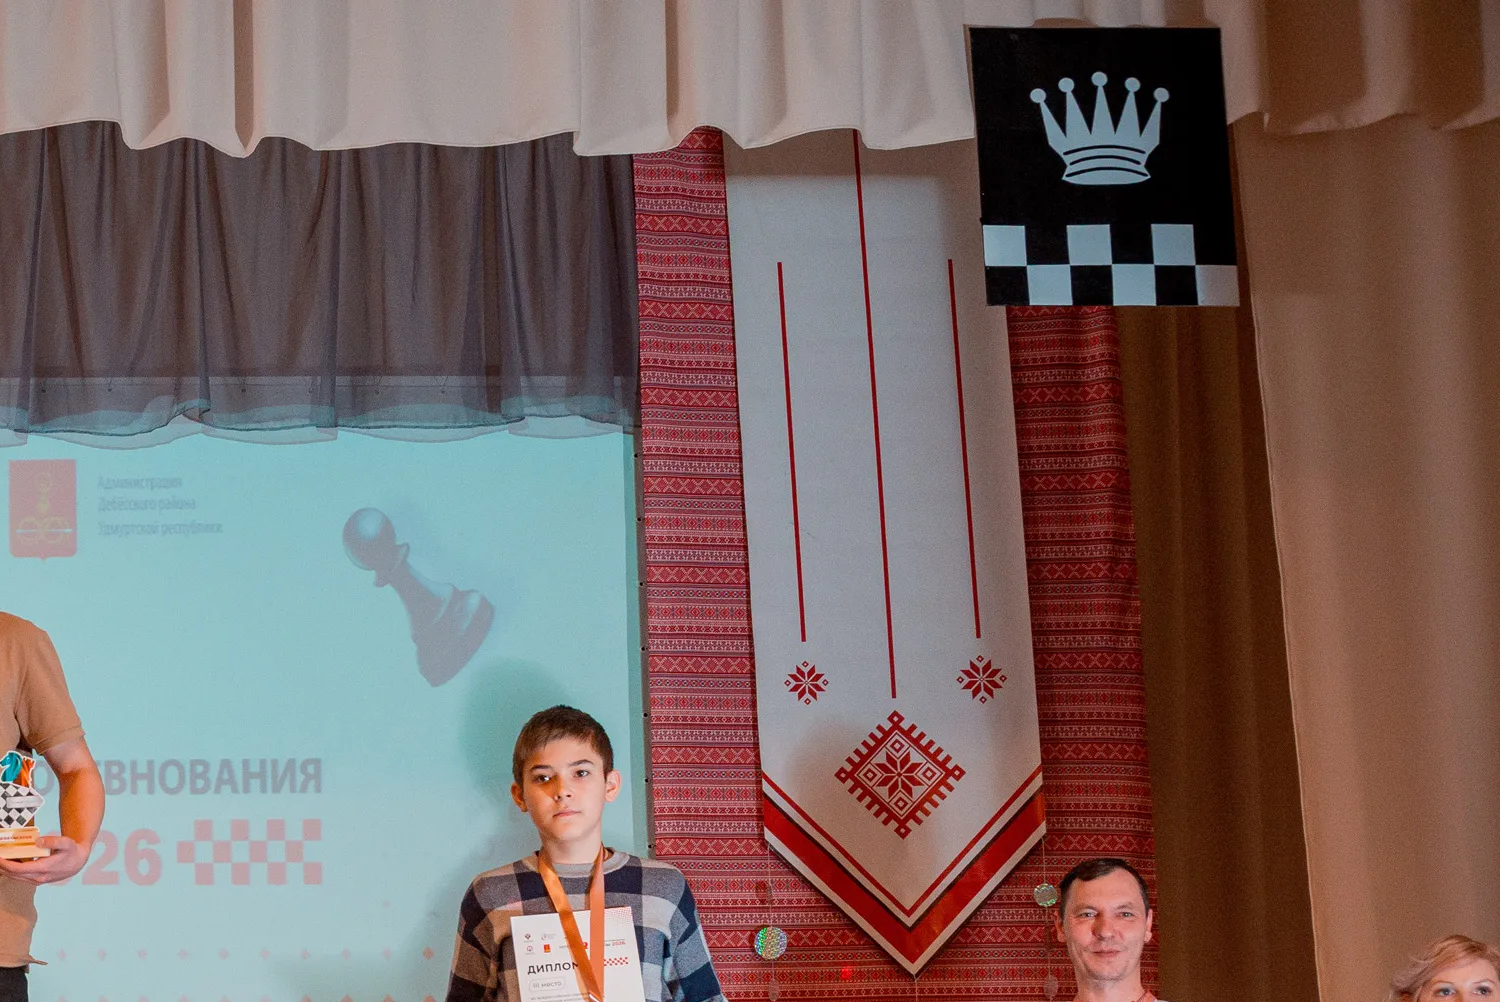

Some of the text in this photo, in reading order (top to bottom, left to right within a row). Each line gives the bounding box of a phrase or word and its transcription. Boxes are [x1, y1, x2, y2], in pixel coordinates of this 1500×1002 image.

[34, 757, 323, 795] ОВНОВАНИЯ
[612, 940, 626, 948] 2026
[541, 980, 562, 989] место
